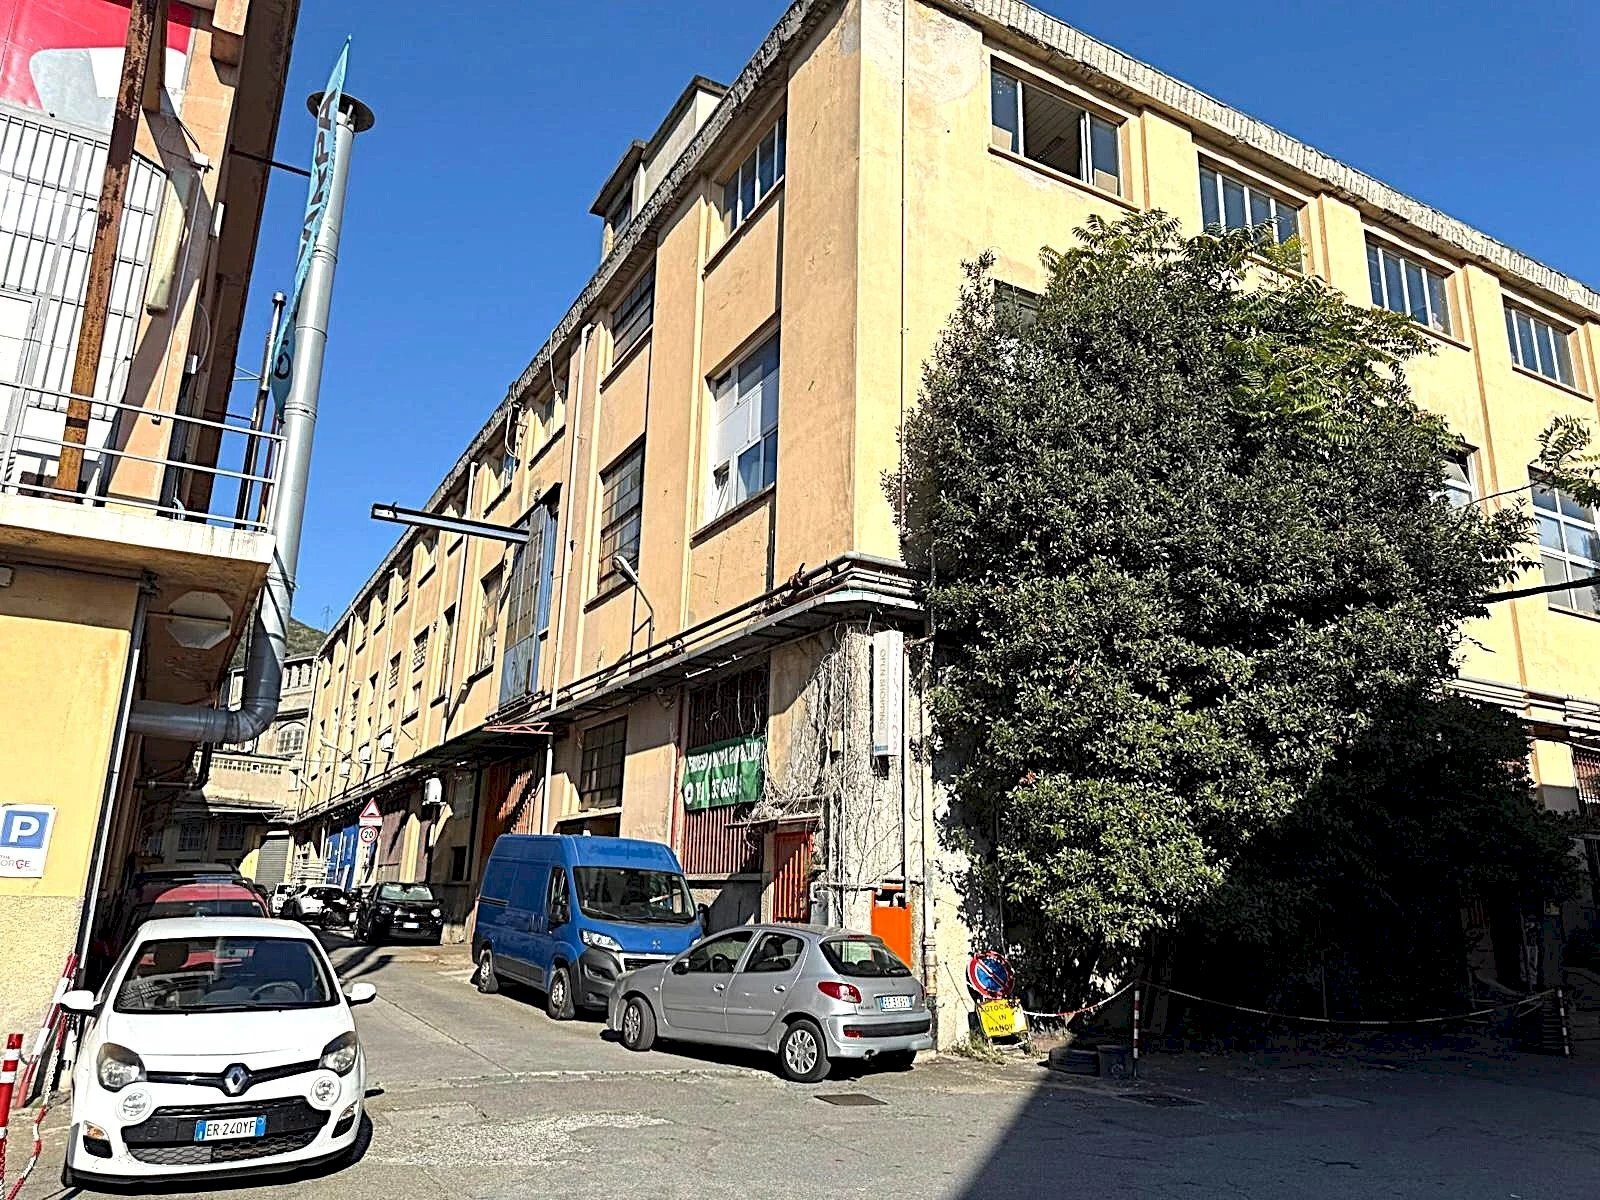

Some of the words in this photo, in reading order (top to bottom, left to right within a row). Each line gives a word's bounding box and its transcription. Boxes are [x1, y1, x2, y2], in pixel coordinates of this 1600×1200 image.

[9, 815, 40, 843] P
[364, 830, 374, 839] 20
[0, 859, 31, 869] ORGE
[206, 1123, 220, 1137] ER
